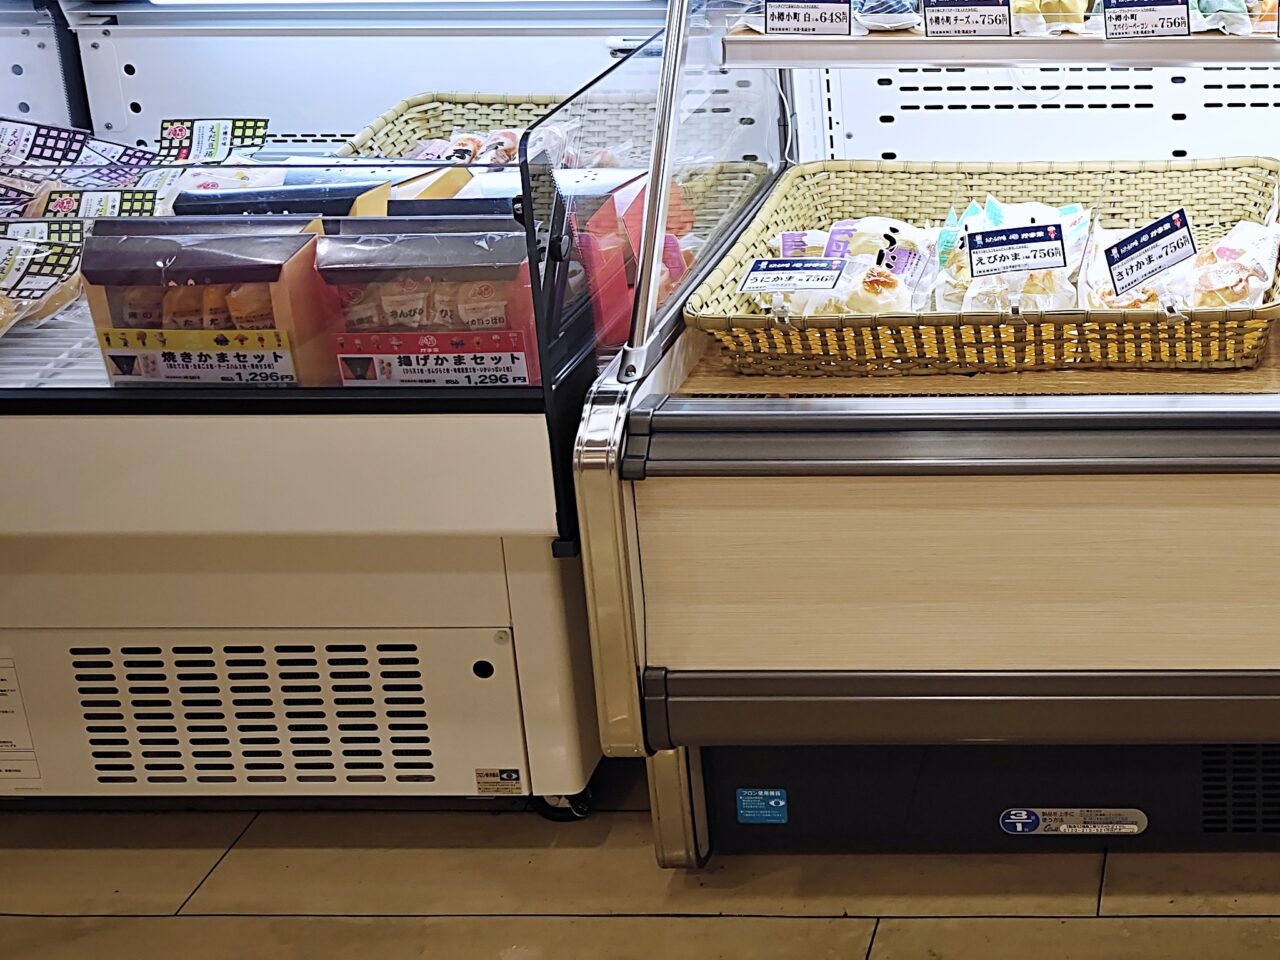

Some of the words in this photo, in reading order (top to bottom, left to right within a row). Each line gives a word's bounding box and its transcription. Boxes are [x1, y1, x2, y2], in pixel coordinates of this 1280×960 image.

[975, 252, 1021, 266] えびかま
[1116, 255, 1154, 282] さけかま
[161, 351, 283, 364] 焼きかまセット
[397, 353, 521, 367] 揚げかまセット
[1010, 810, 1028, 820] 3
[1015, 822, 1023, 832] 1
